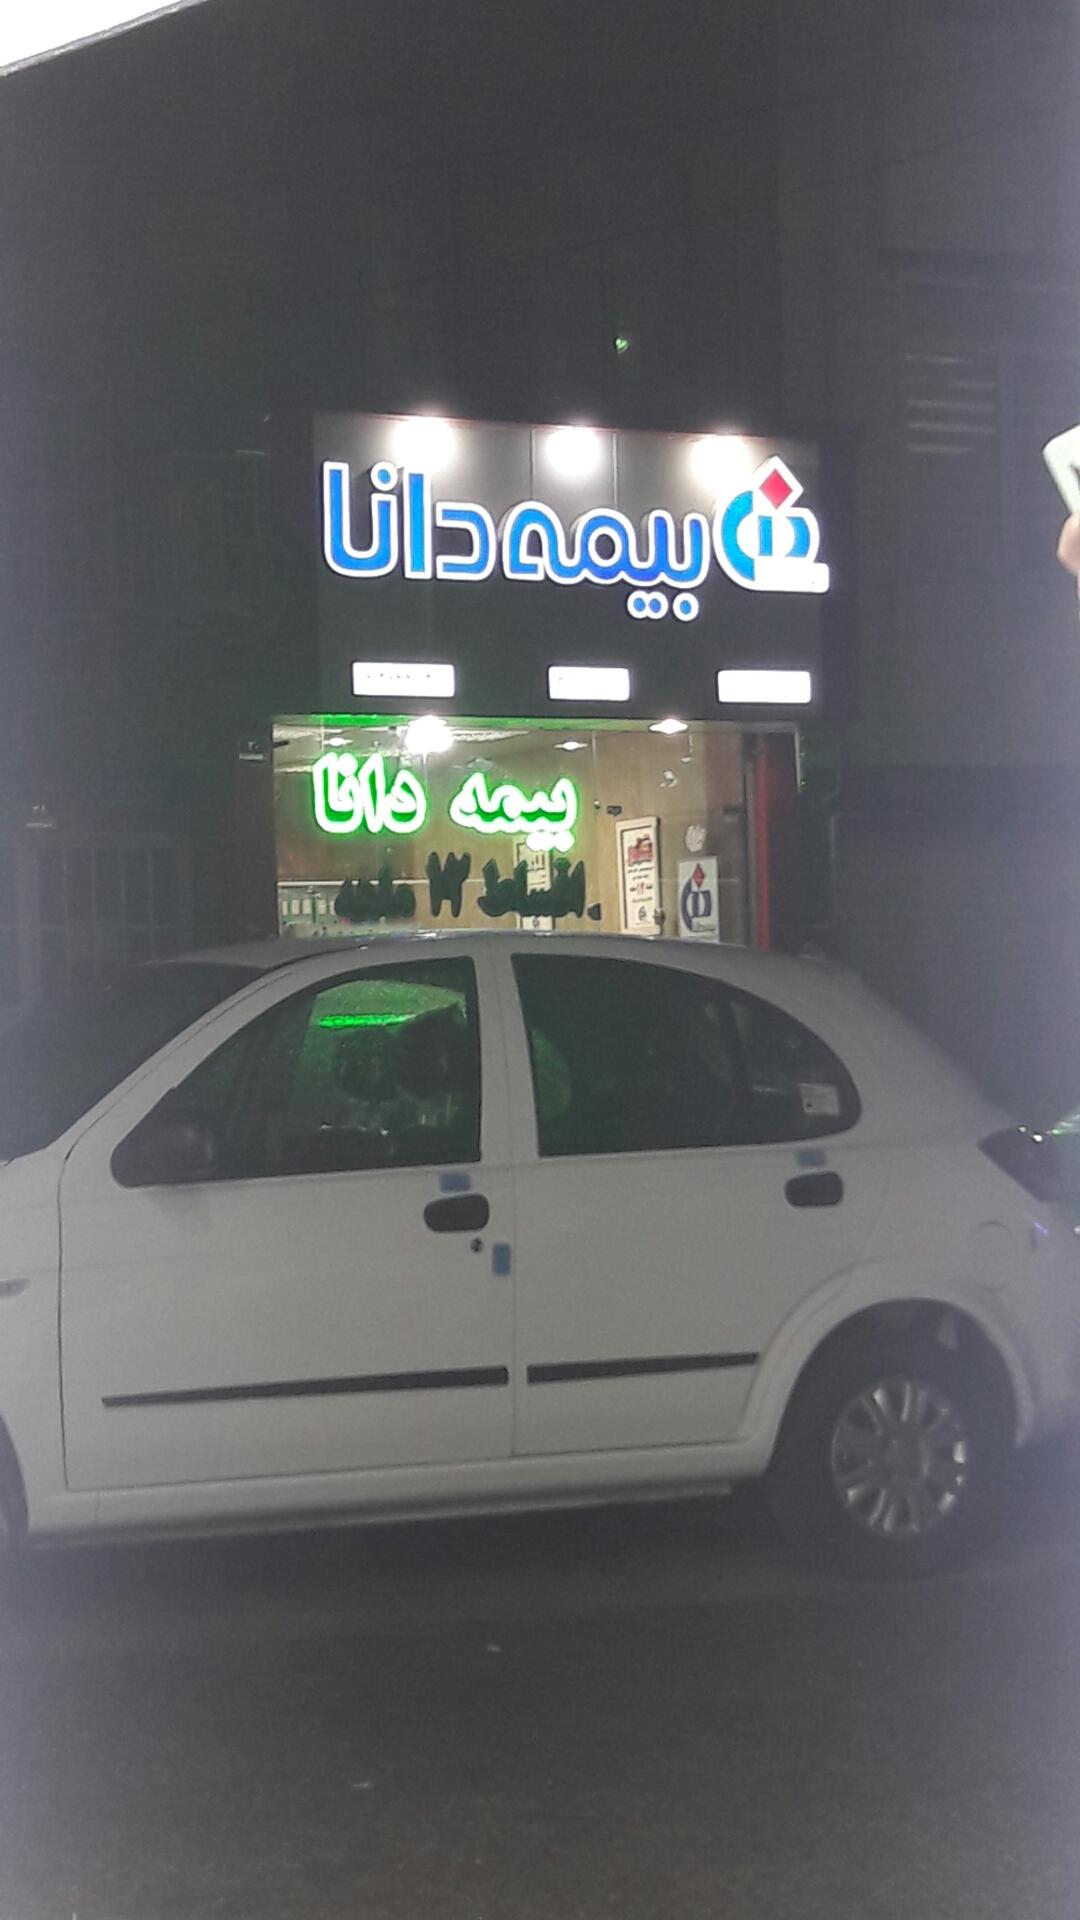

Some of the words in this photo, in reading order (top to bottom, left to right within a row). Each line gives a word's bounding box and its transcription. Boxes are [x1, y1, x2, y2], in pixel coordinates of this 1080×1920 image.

[322, 460, 497, 582] دانا
[502, 500, 711, 622] بیمه
[311, 751, 427, 834] دانا
[449, 771, 578, 852] بیمه
